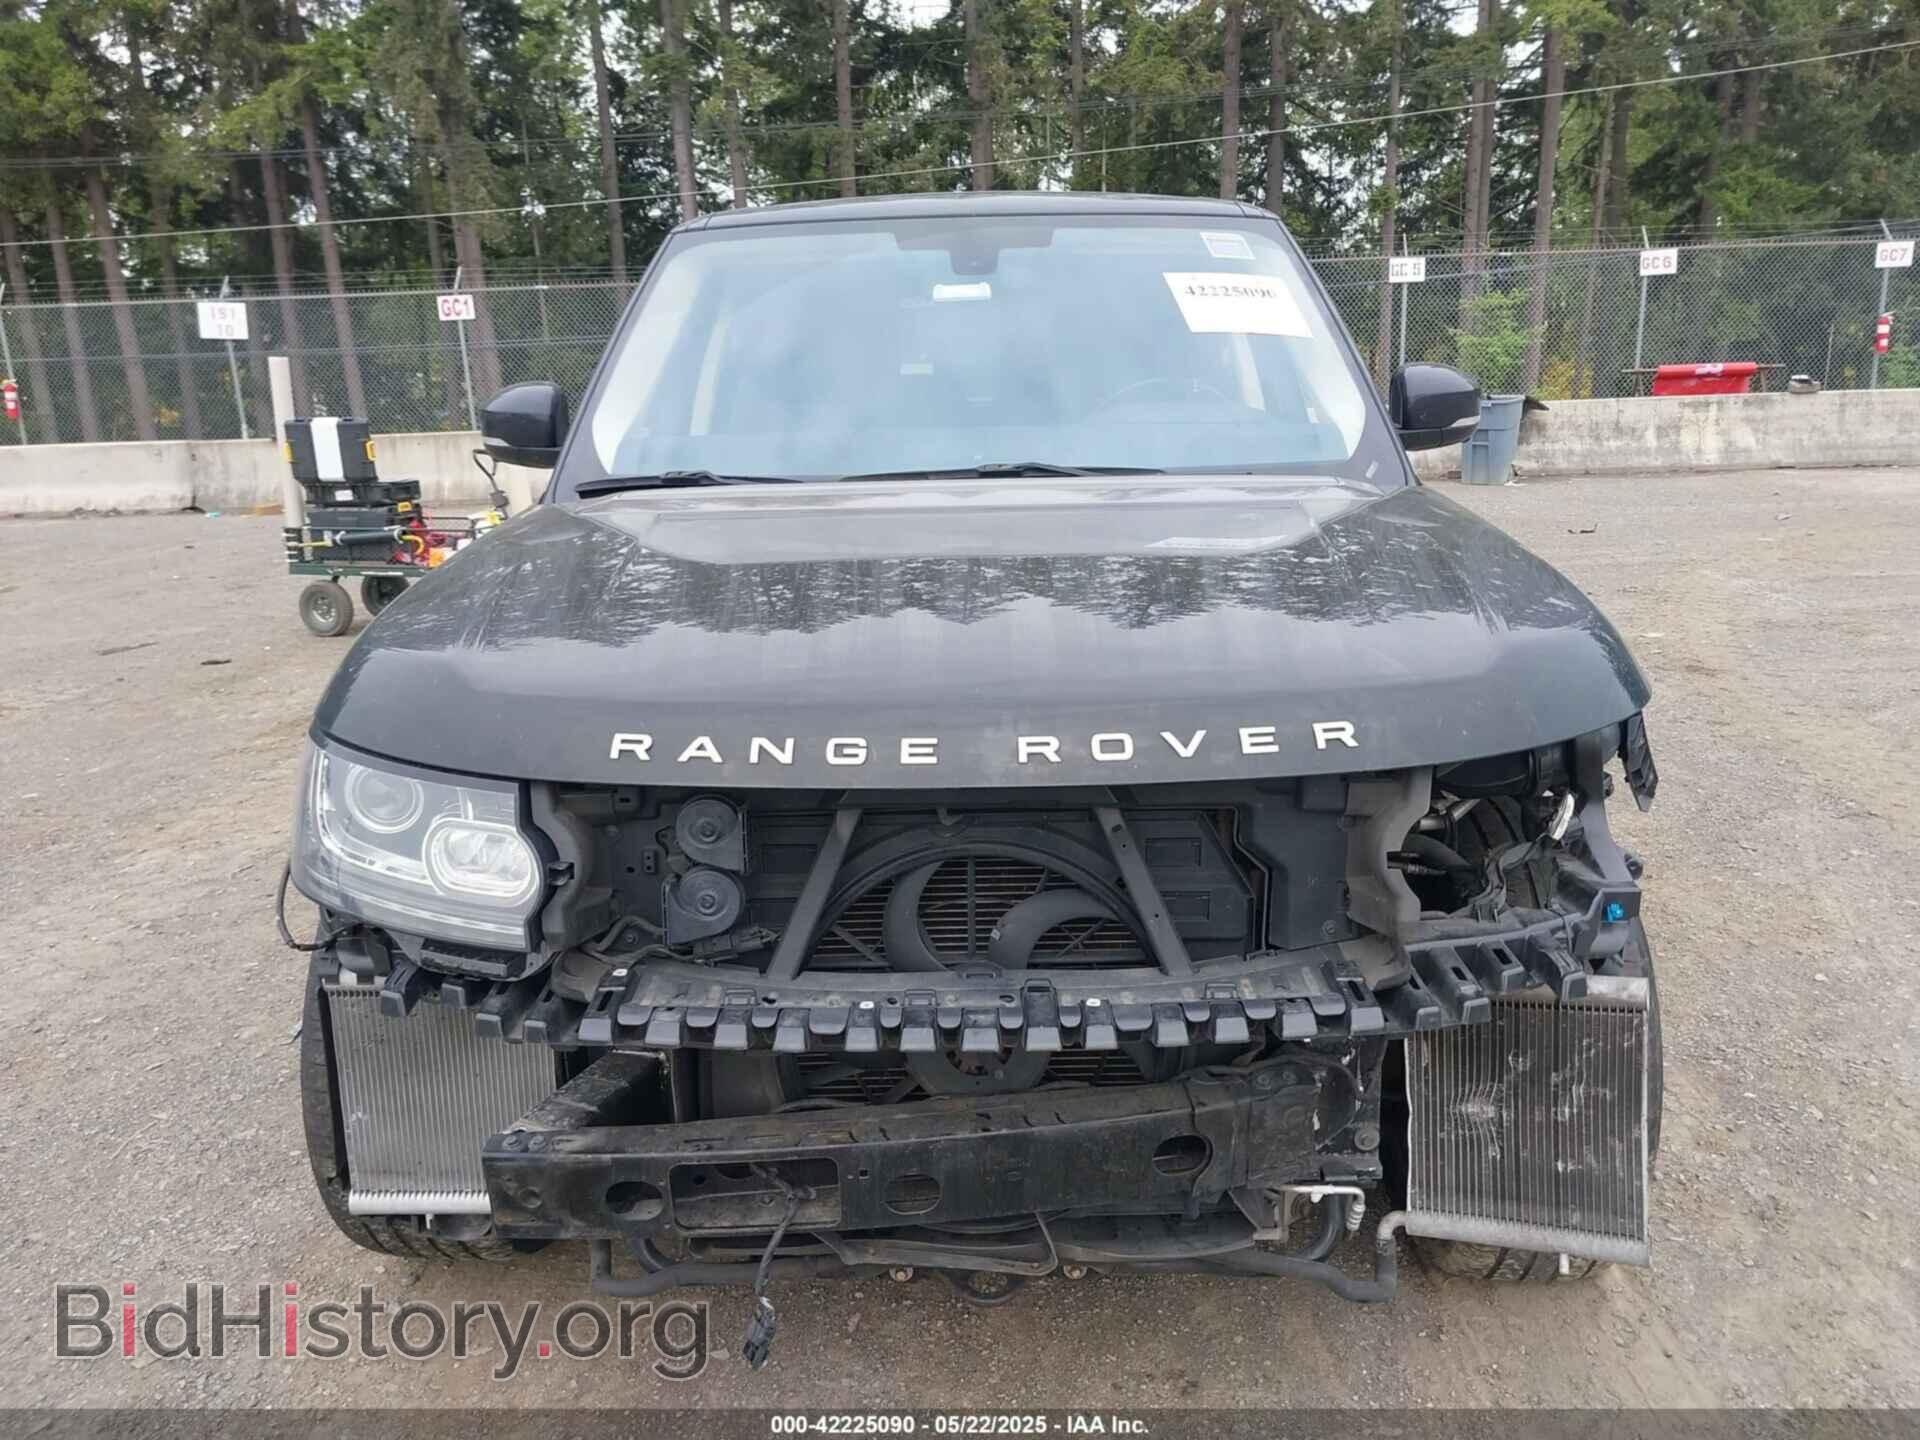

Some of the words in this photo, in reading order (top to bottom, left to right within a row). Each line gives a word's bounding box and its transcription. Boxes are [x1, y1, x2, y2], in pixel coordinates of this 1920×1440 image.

[1880, 248, 1908, 261] GC7
[441, 298, 470, 317] GC1
[609, 733, 939, 765] RANGE
[1017, 721, 1359, 763] ROVER
